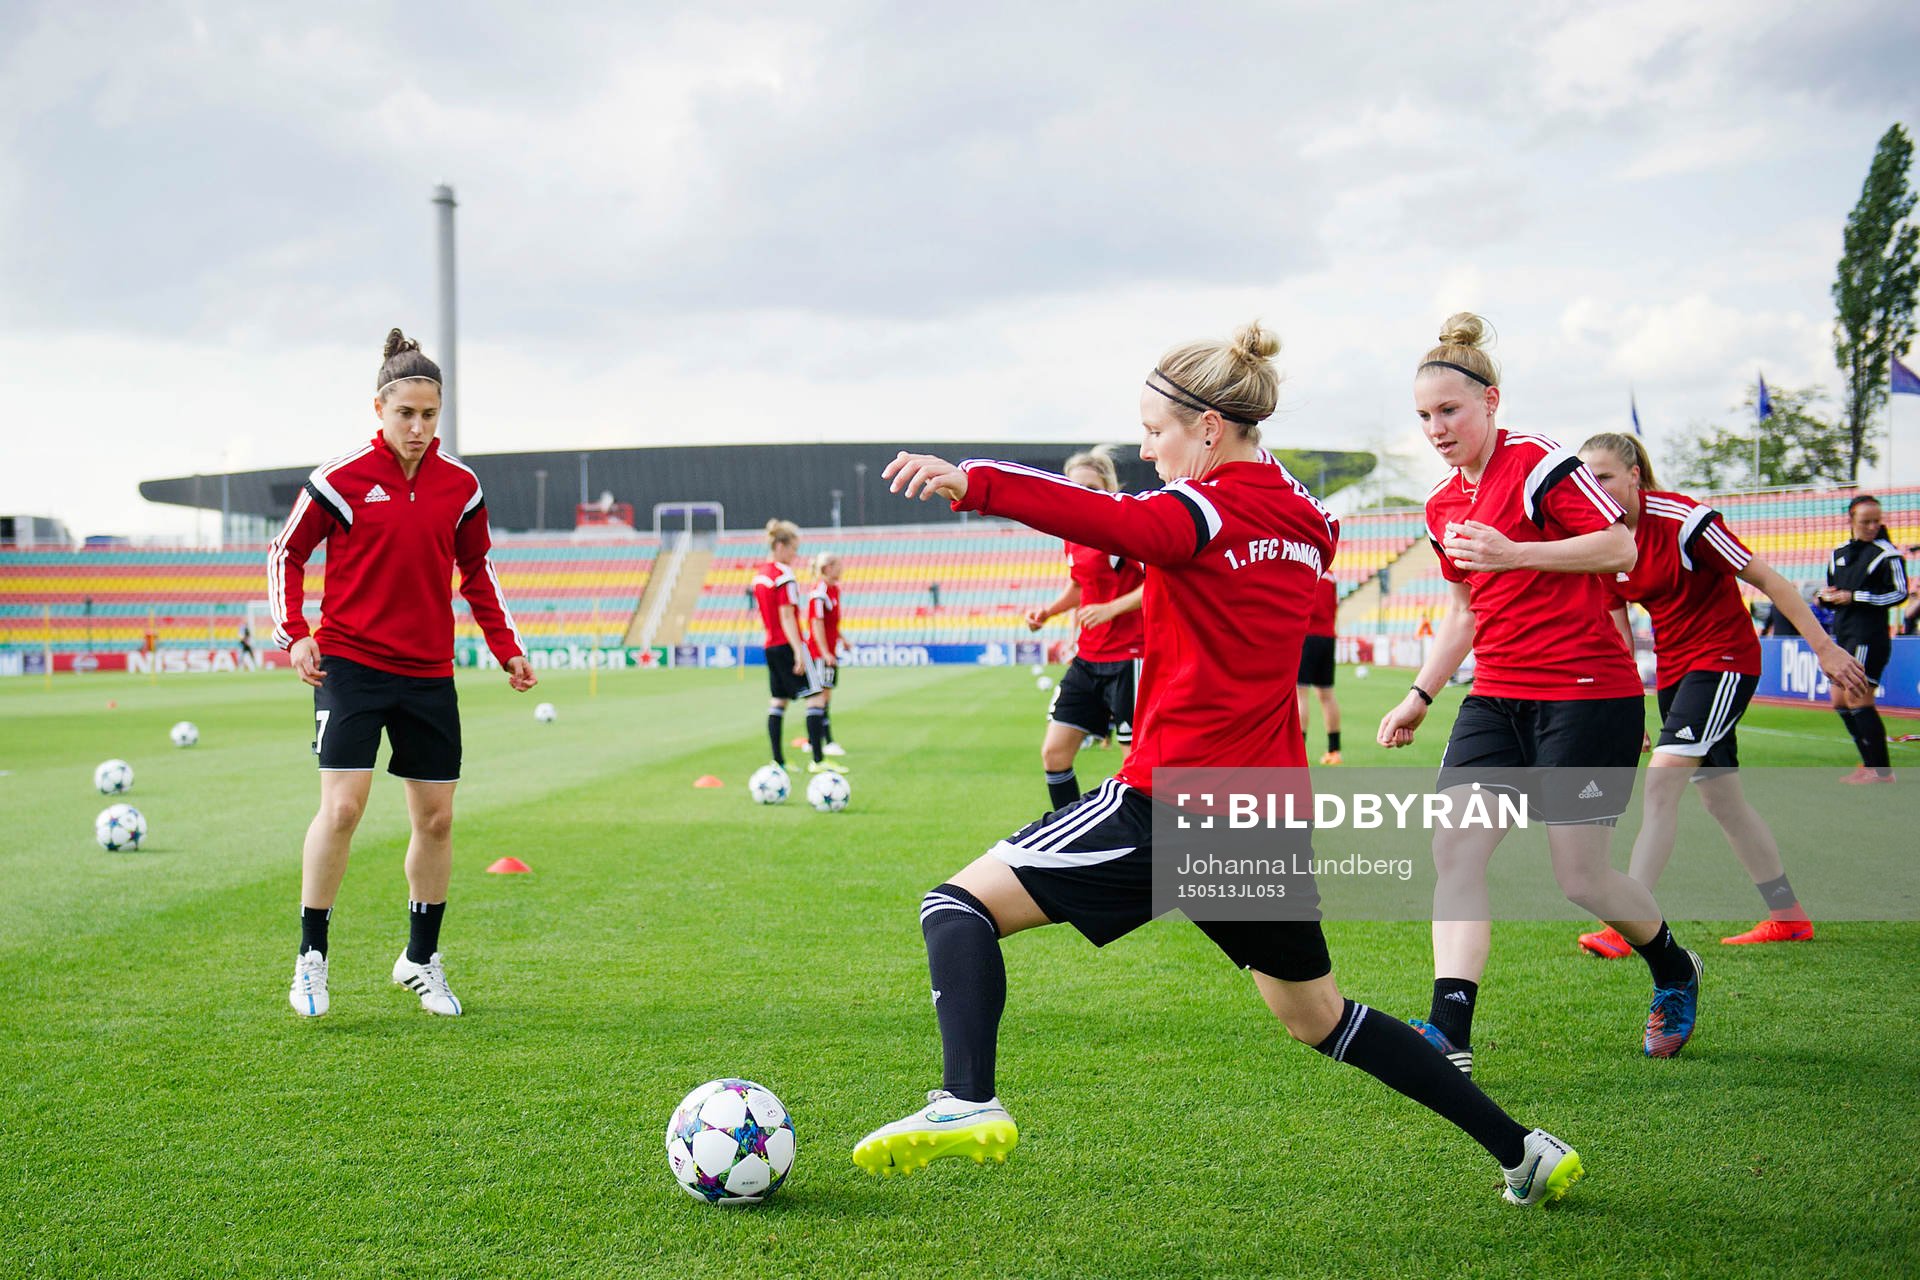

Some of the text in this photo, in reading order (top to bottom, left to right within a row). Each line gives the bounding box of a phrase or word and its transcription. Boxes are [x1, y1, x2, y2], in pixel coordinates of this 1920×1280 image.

[1224, 549, 1247, 570] 1.
[1249, 538, 1279, 563] FFC
[127, 650, 264, 673] NISSAN
[316, 710, 330, 754] 7
